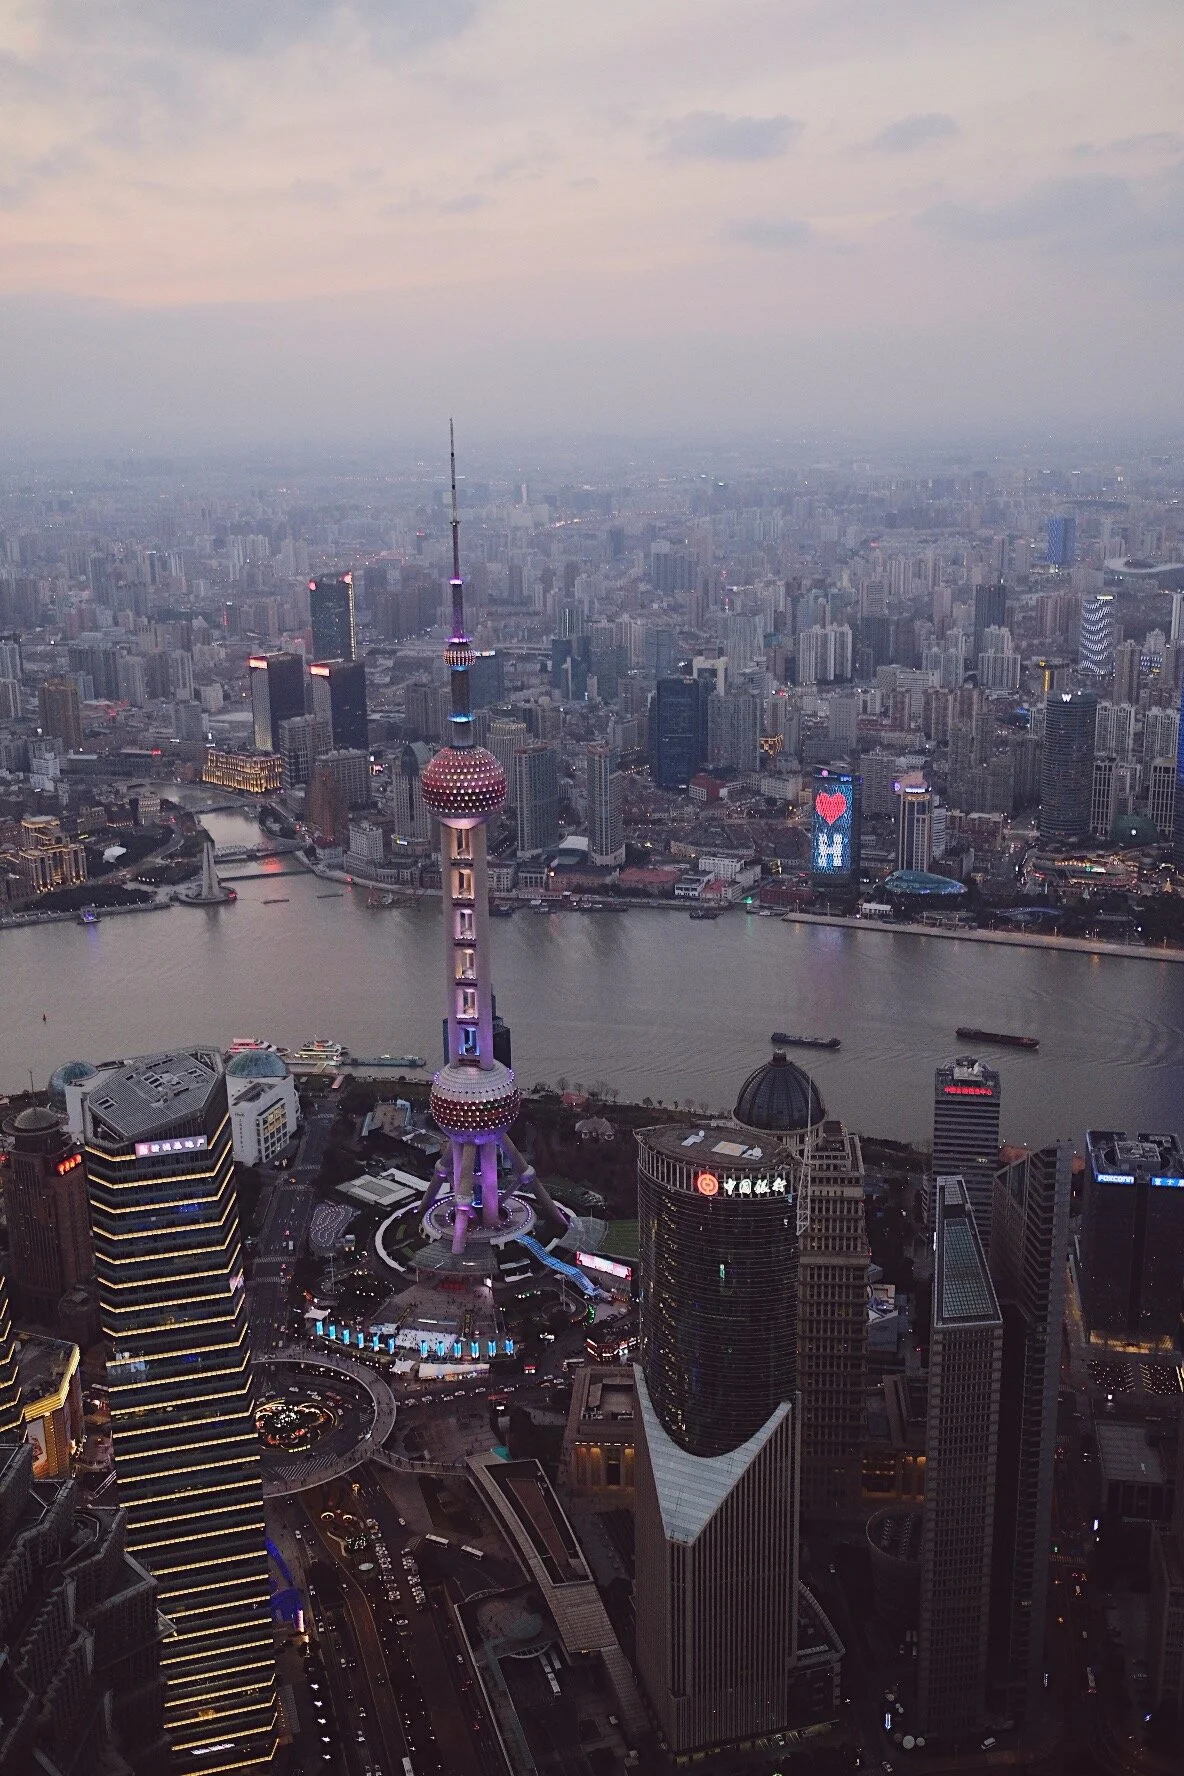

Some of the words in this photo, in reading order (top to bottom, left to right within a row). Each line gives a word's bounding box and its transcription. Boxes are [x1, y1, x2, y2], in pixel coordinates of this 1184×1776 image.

[1062, 693, 1072, 702] W
[723, 1177, 788, 1196] 中国银行
